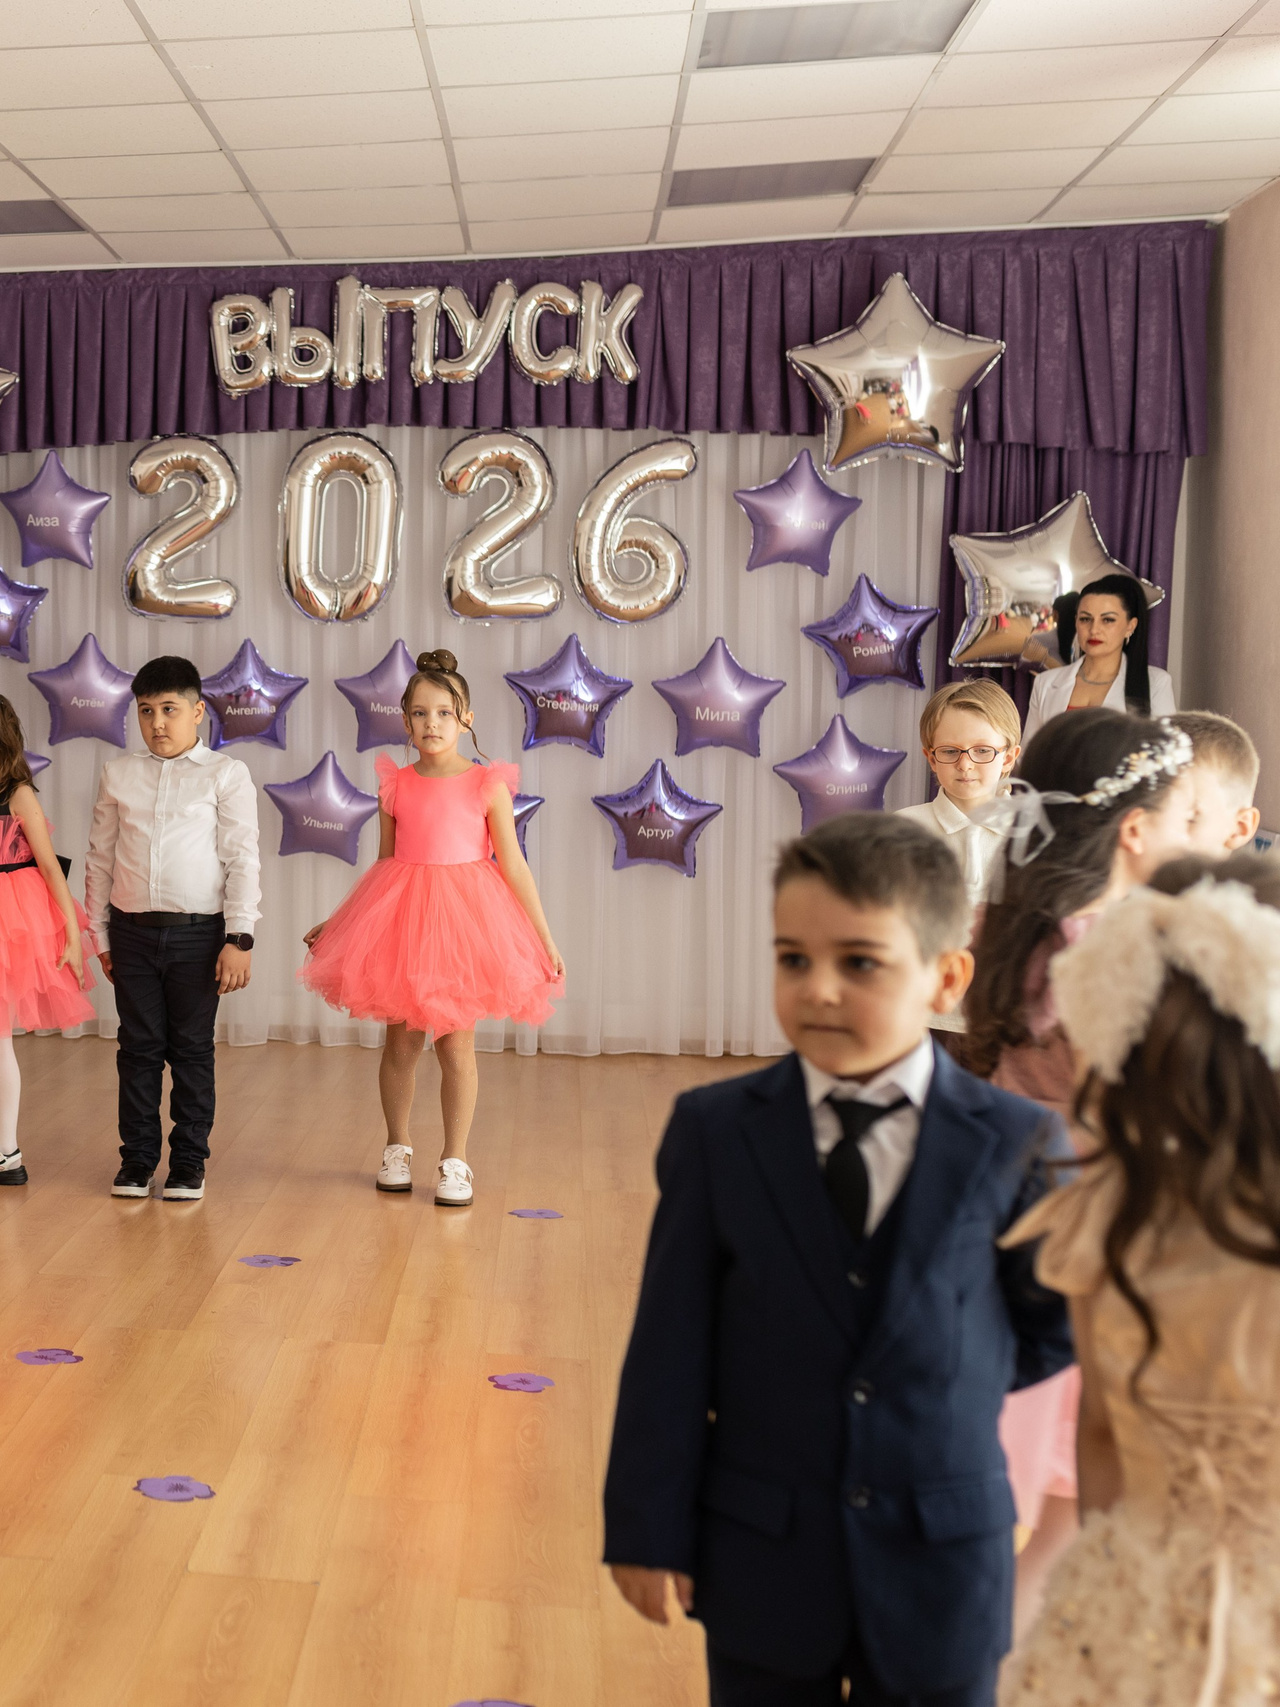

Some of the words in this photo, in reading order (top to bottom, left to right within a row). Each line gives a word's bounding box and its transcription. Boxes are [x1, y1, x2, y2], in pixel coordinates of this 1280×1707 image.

[210, 273, 644, 399] ВЫПУСК
[26, 514, 60, 527] Аиза
[124, 430, 698, 625] 2026
[852, 643, 895, 658] Роман
[70, 696, 106, 709] Артём
[536, 696, 600, 713] Стефания
[225, 705, 276, 716] Ангелина
[695, 706, 741, 721] Мила
[825, 783, 868, 796] Элина
[303, 816, 344, 831] Ульяна
[637, 825, 675, 840] Артур
